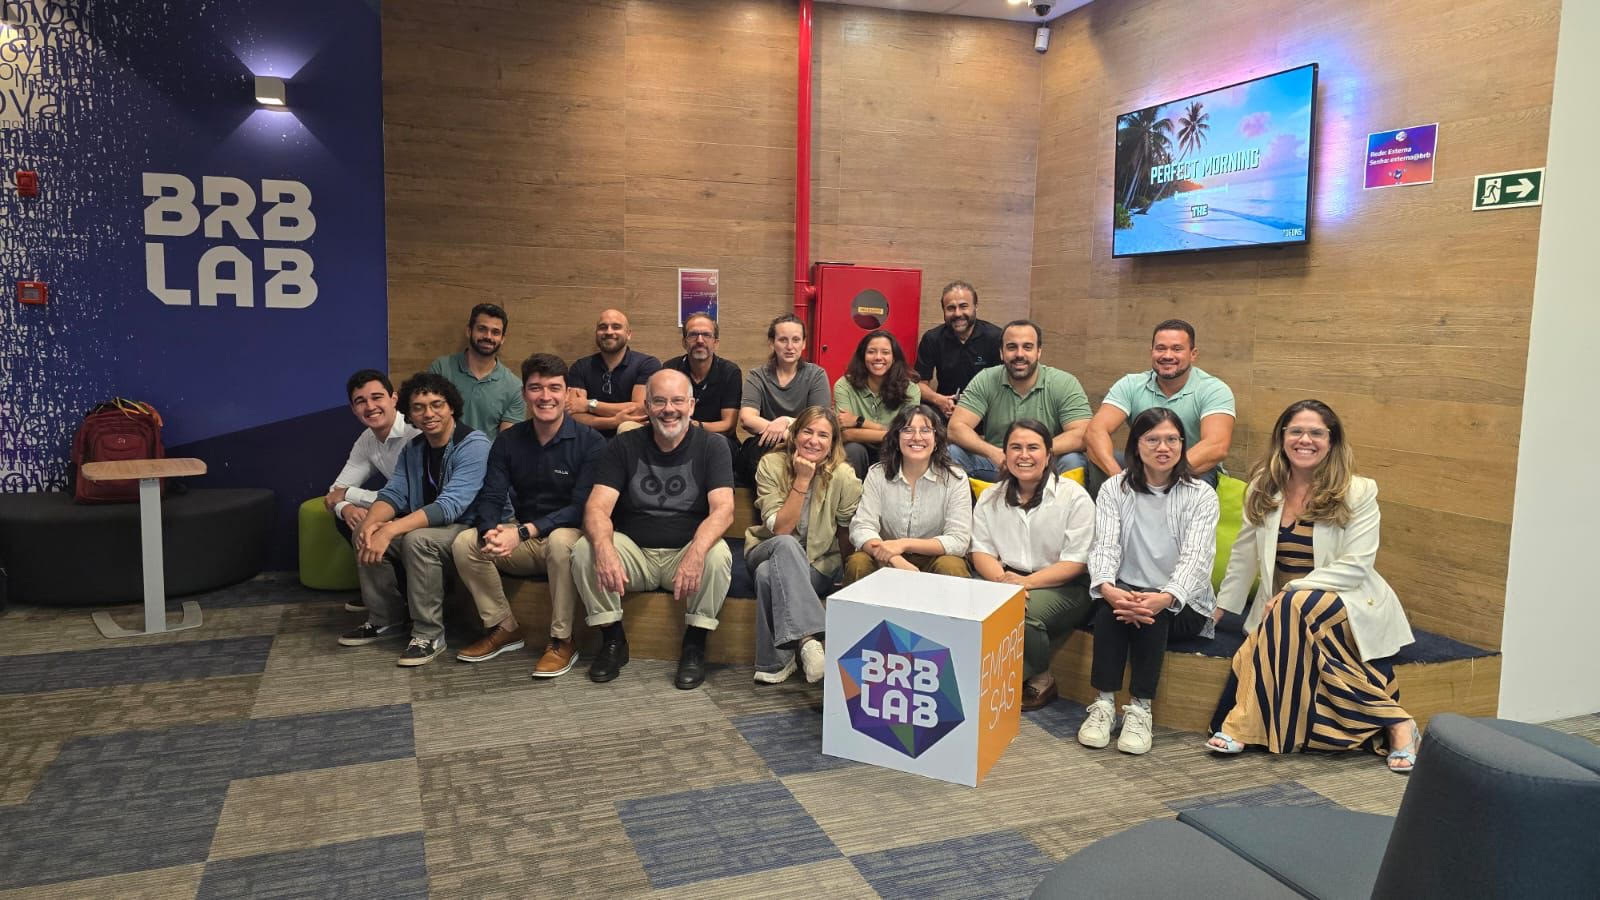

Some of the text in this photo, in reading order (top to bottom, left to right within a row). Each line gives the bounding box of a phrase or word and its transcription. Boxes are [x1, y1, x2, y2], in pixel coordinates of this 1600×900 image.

[1150, 148, 1260, 185] PERFECT MORNING
[1387, 147, 1412, 155] Externa
[142, 172, 317, 241] BRB
[1191, 204, 1208, 218] THE
[145, 242, 319, 309] LAB
[861, 648, 940, 694] BRB
[980, 620, 1024, 697] EMPRE
[860, 682, 940, 729] LAB
[988, 671, 1016, 730] SAS
